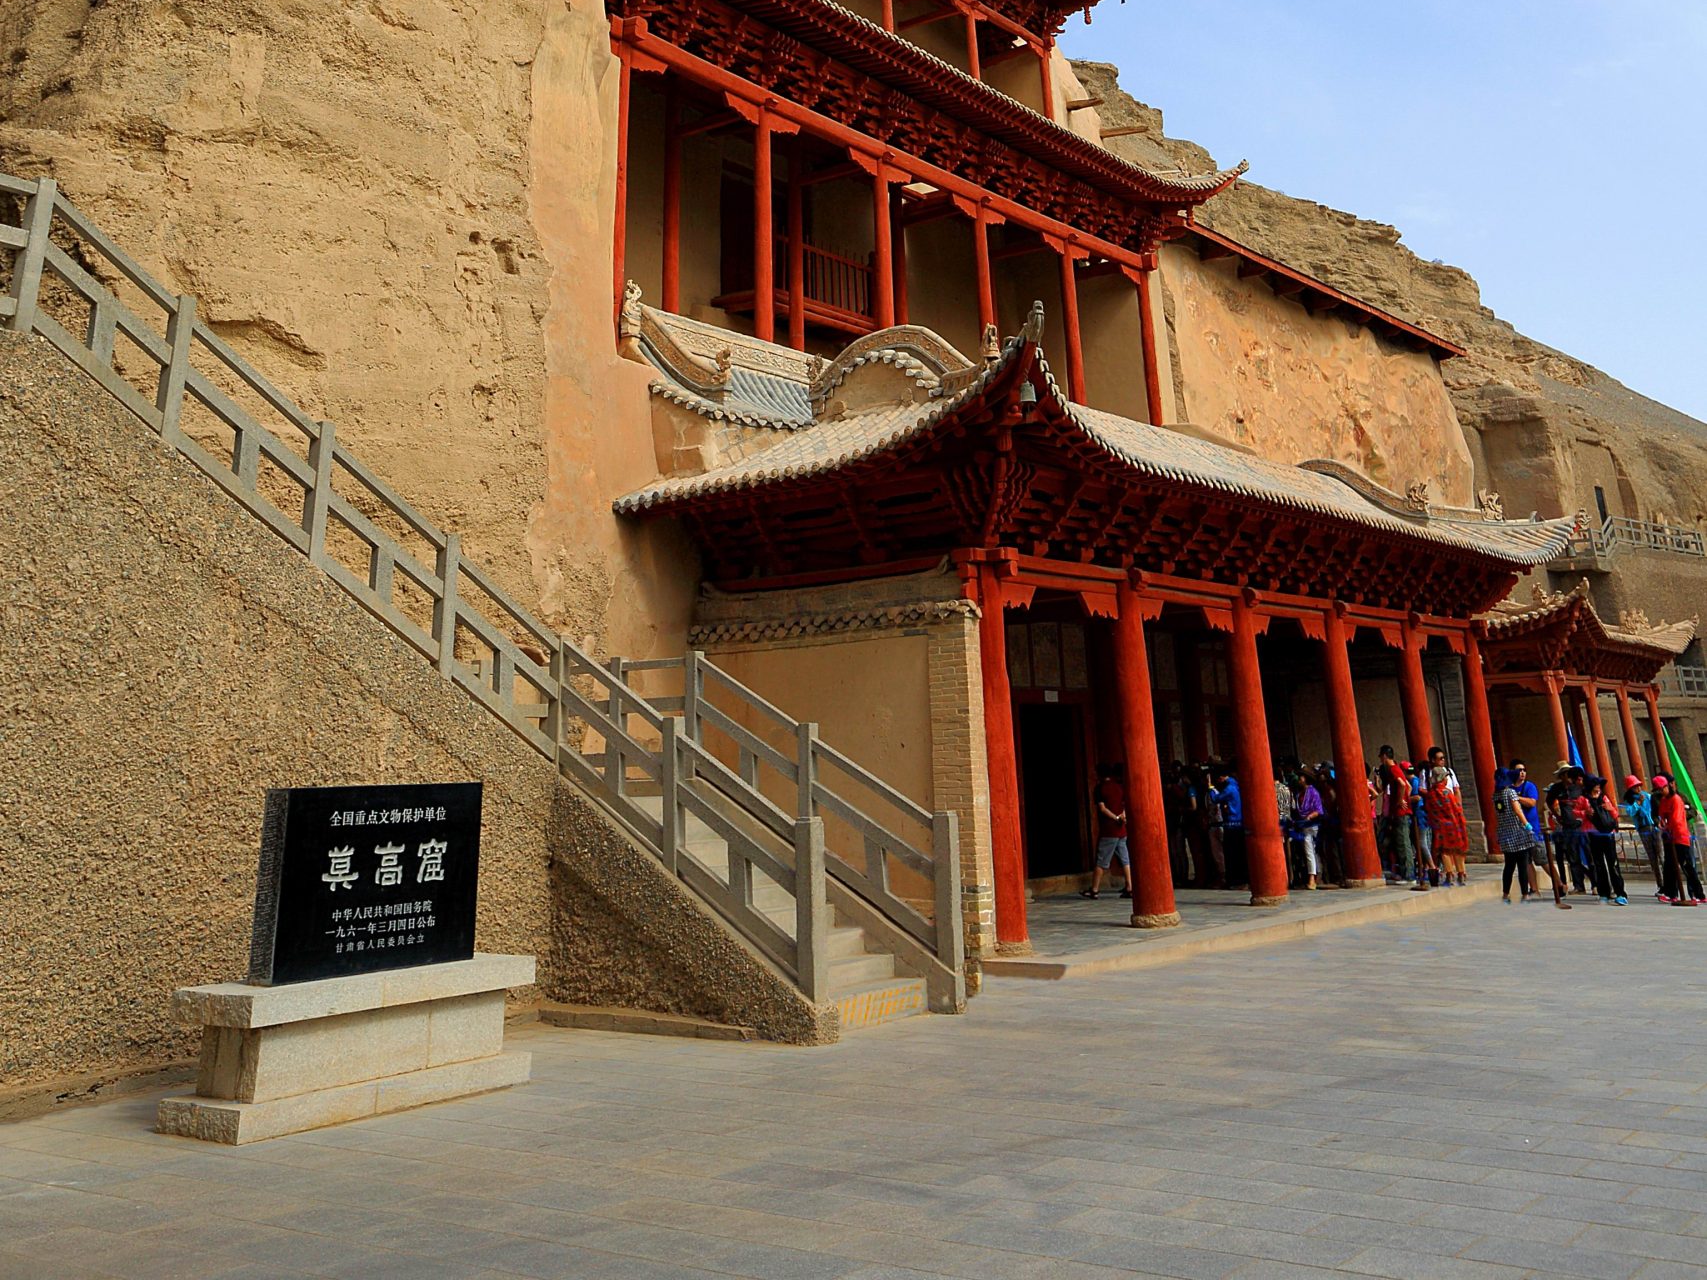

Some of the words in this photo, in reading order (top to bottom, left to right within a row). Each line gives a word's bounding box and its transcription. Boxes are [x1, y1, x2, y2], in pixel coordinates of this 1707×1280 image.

[329, 806, 447, 827] 全国重点文物保护单位
[321, 838, 448, 892] 莫高窟
[331, 900, 433, 922] 中华人民共和国国务院
[325, 915, 436, 938] 一九六一年三月四日公布
[335, 933, 425, 954] 甘肃省人民委员会立
